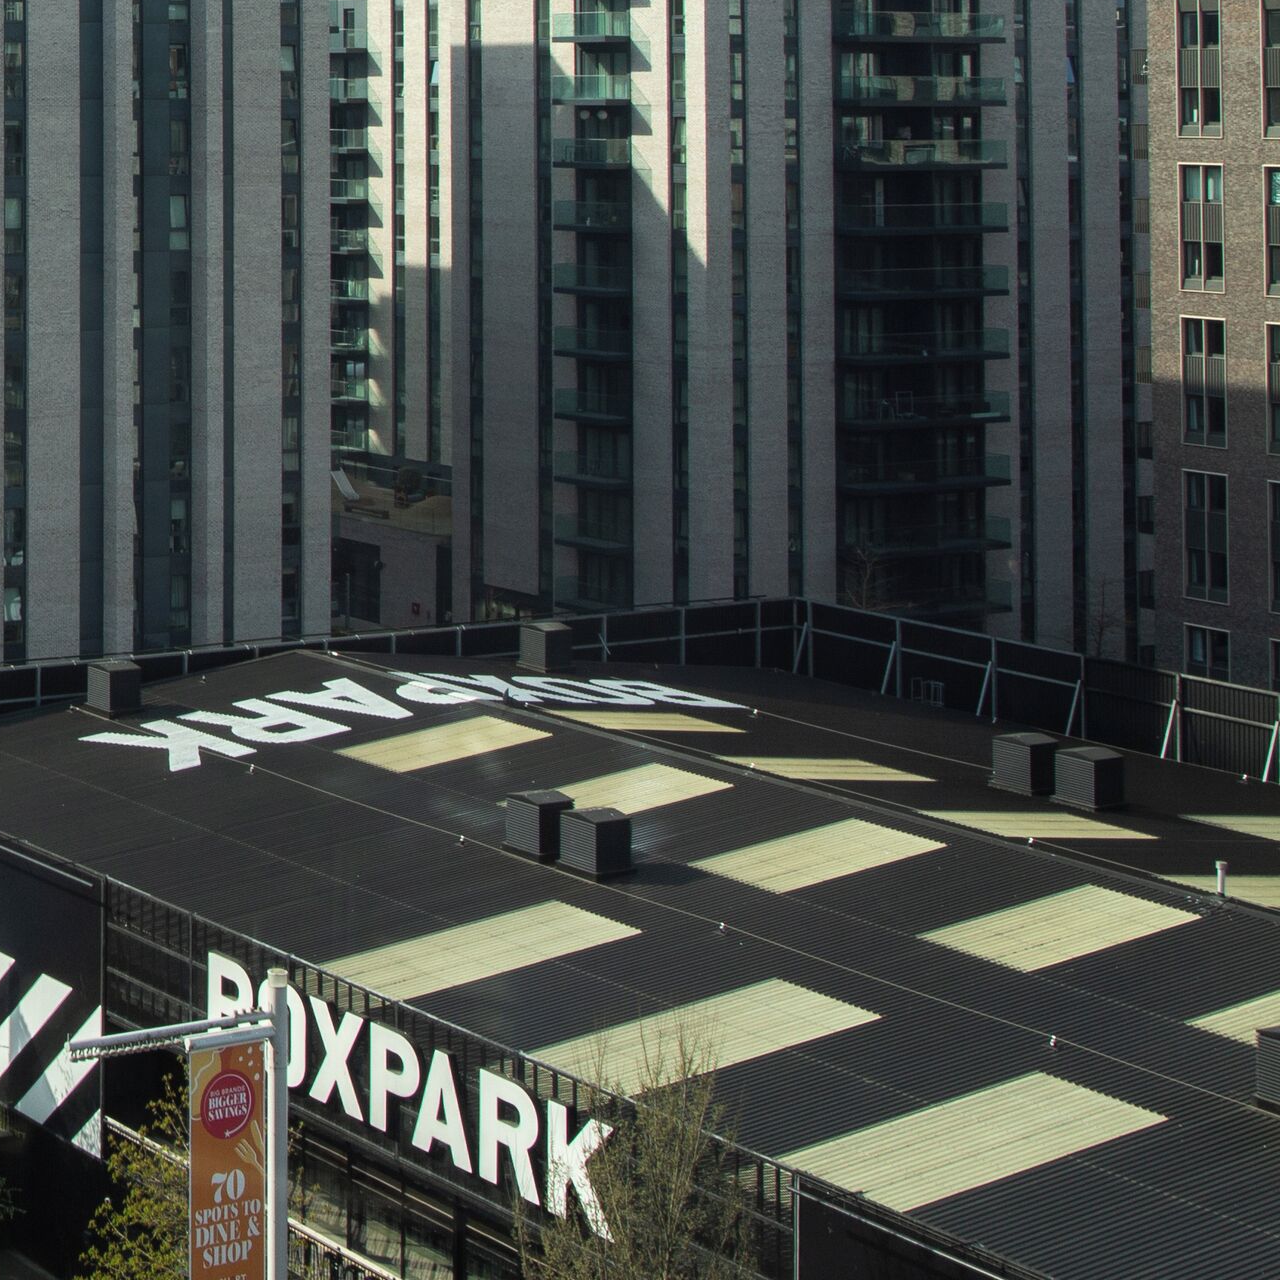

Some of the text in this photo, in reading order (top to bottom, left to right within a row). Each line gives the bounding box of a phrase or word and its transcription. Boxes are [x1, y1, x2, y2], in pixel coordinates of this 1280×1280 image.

[78, 671, 746, 773] BOXPARK
[208, 951, 615, 1244] BOXPARK
[208, 1093, 247, 1110] BIGGER
[209, 1085, 246, 1098] BIG BRANDS
[208, 1104, 248, 1122] SAVINGS
[210, 1168, 246, 1205] 70
[194, 1198, 261, 1227] SPOTS TO
[195, 1215, 260, 1248] DINE &
[203, 1239, 253, 1270] SHOP
